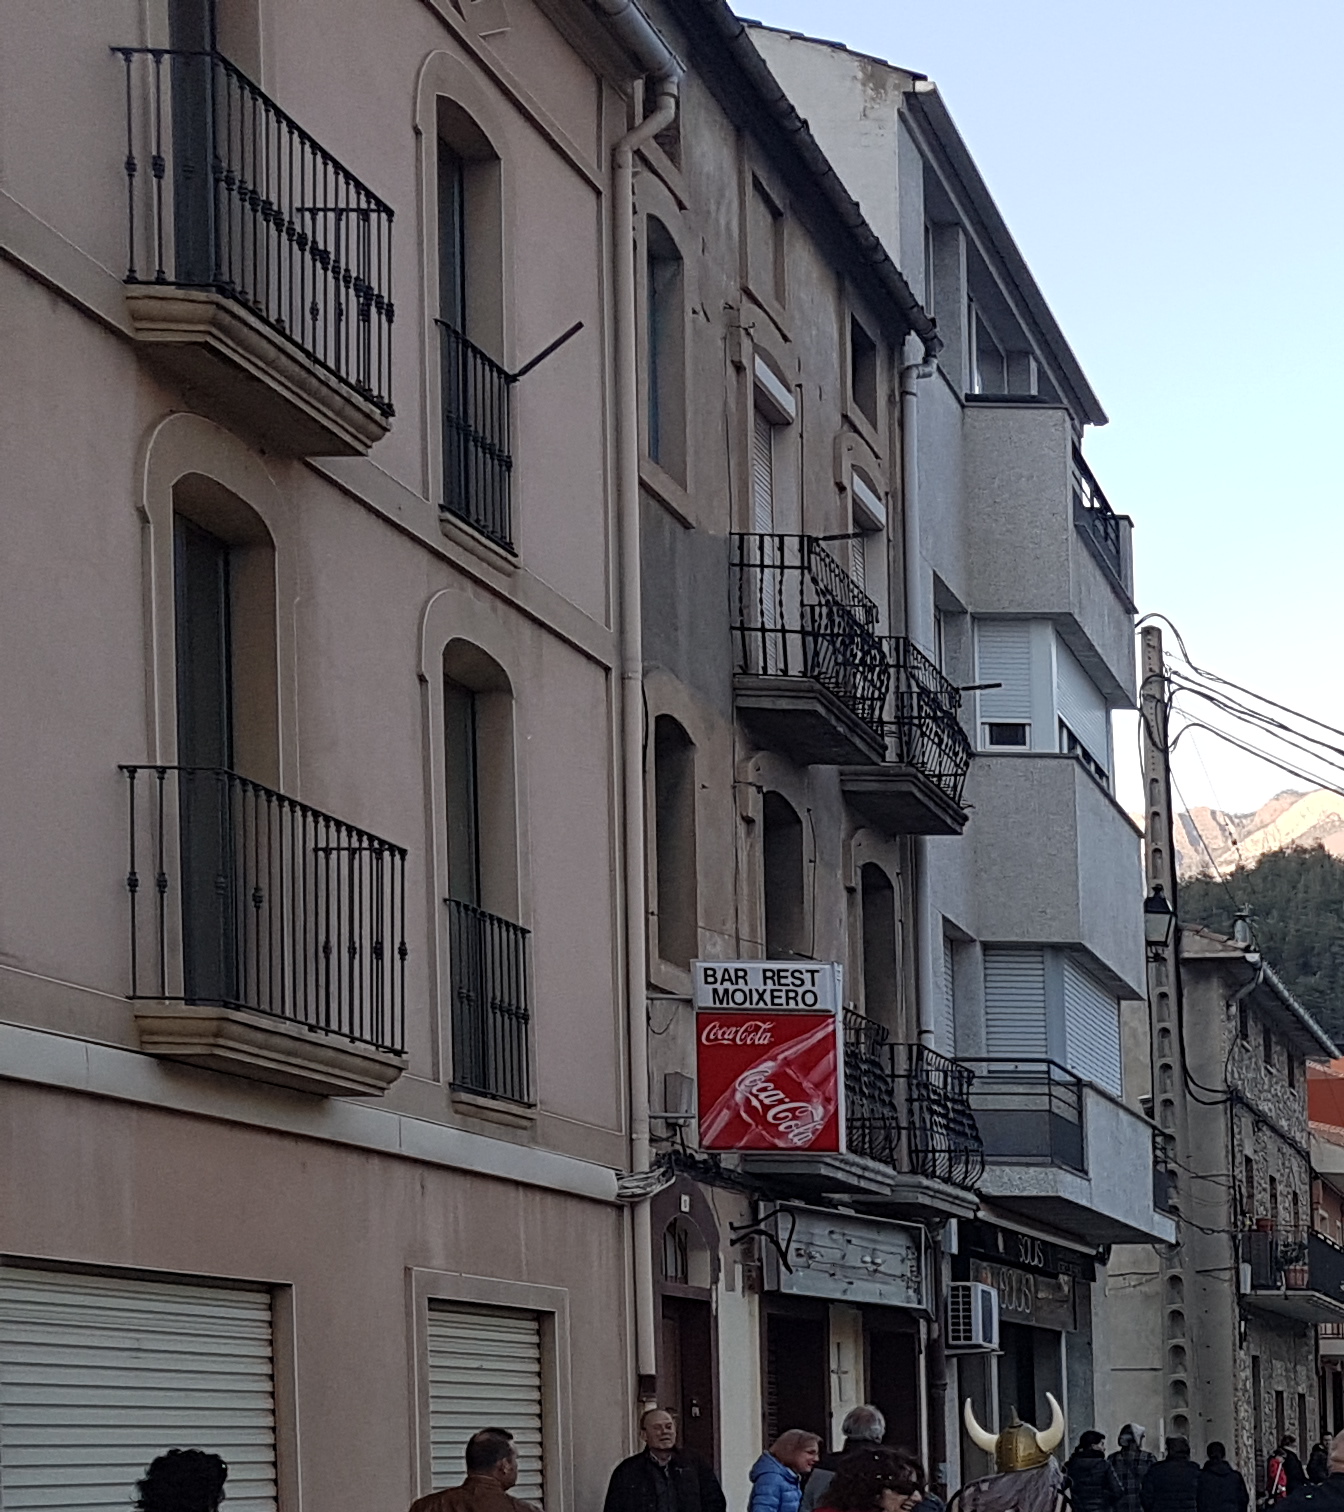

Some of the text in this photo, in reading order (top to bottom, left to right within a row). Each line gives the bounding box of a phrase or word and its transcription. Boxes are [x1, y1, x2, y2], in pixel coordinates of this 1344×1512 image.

[703, 967, 820, 987] BAR REST
[712, 988, 818, 1007] MOIXERO
[701, 1021, 776, 1045] Coca-Cola
